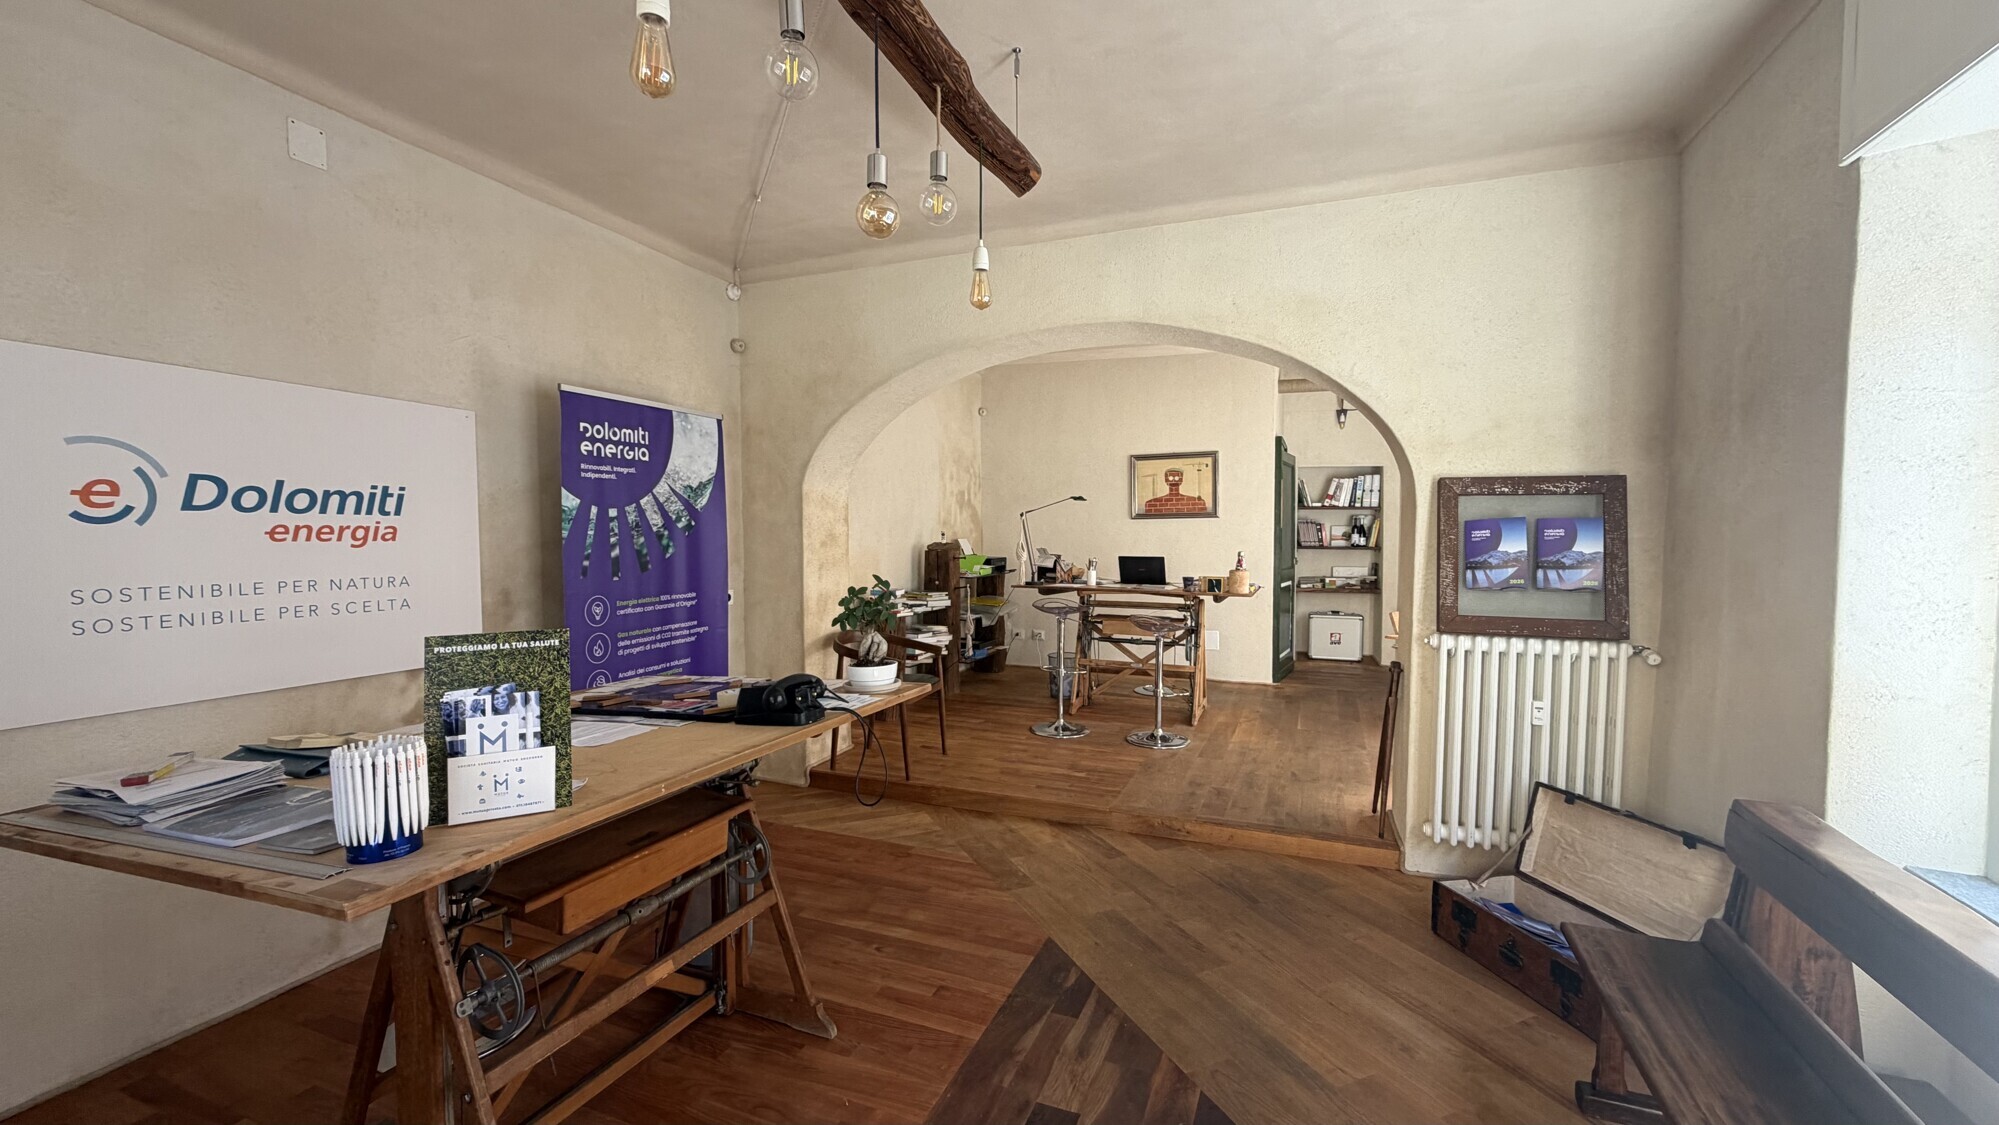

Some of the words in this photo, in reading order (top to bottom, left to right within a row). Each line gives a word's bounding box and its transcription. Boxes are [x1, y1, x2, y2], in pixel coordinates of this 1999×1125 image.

[580, 441, 650, 462] energia
[180, 473, 406, 517] Dolomiti
[264, 520, 398, 549] energia
[70, 581, 265, 606] SOSTENIBILE
[278, 579, 319, 594] PER
[330, 575, 411, 591] NATURA
[71, 607, 266, 636] SOSTENIBILE
[279, 604, 319, 619] PER
[331, 597, 411, 616] SCELTA
[433, 643, 498, 654] PROTEGGIAMO
[499, 642, 510, 650] LA
[511, 640, 529, 649] TUA
[529, 639, 560, 648] SALUTE
